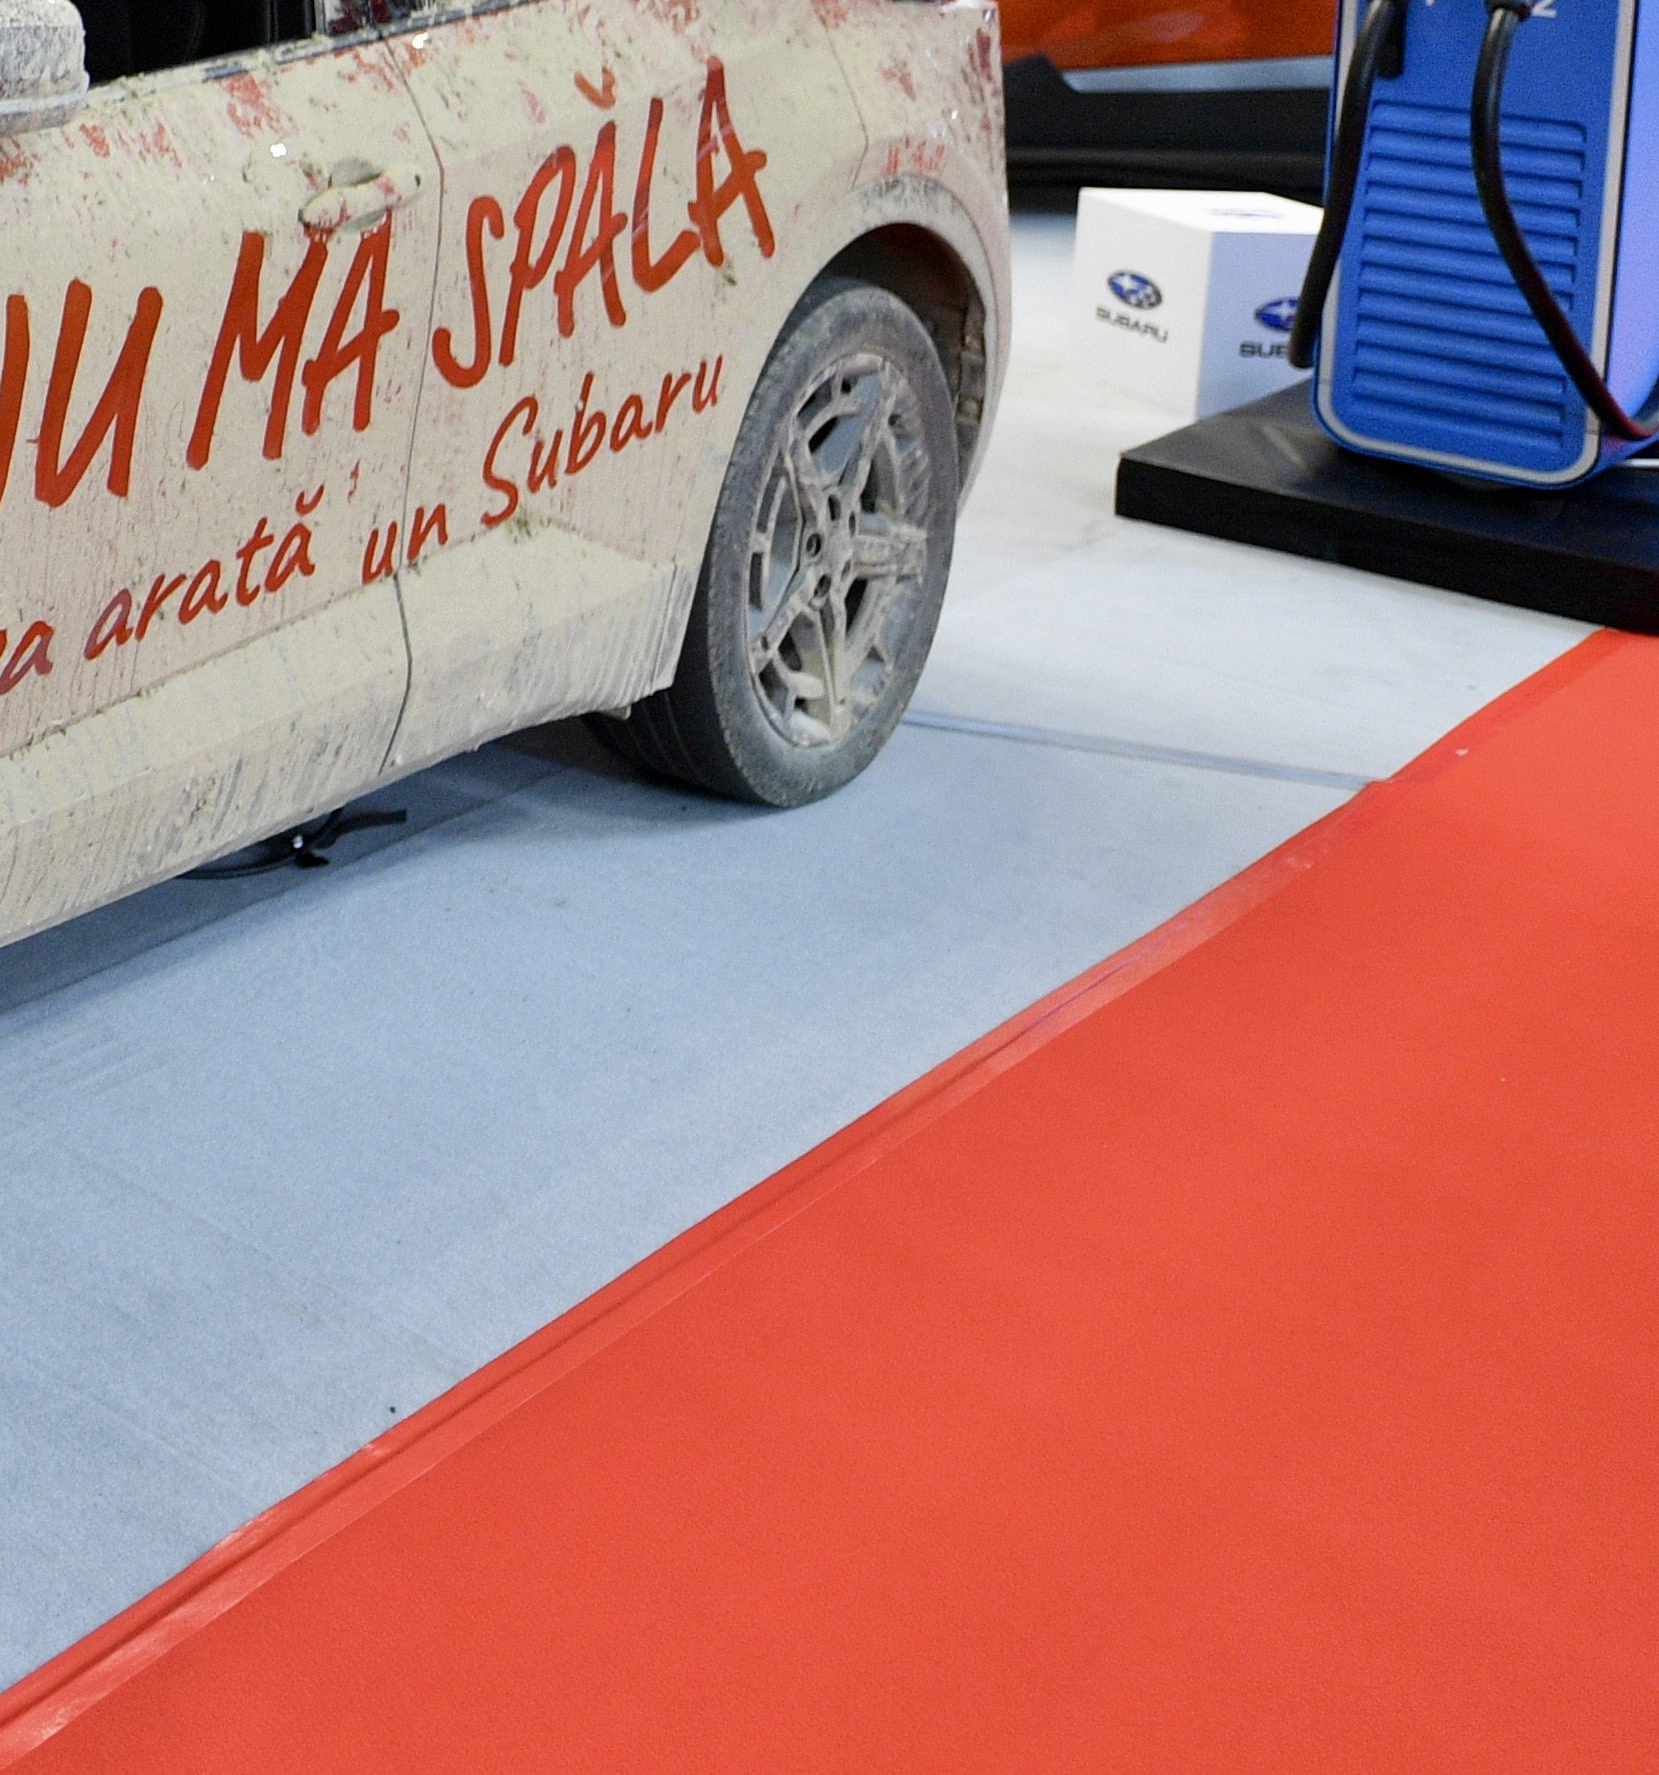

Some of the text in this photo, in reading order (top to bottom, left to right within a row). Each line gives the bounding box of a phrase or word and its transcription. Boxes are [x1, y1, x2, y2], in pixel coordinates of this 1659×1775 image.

[430, 56, 776, 389] SPĂLA
[1095, 307, 1169, 343] SUBARU
[1239, 340, 1290, 359] SUB
[83, 482, 316, 663] arată
[361, 503, 449, 584] un
[481, 357, 725, 526] Subaru
